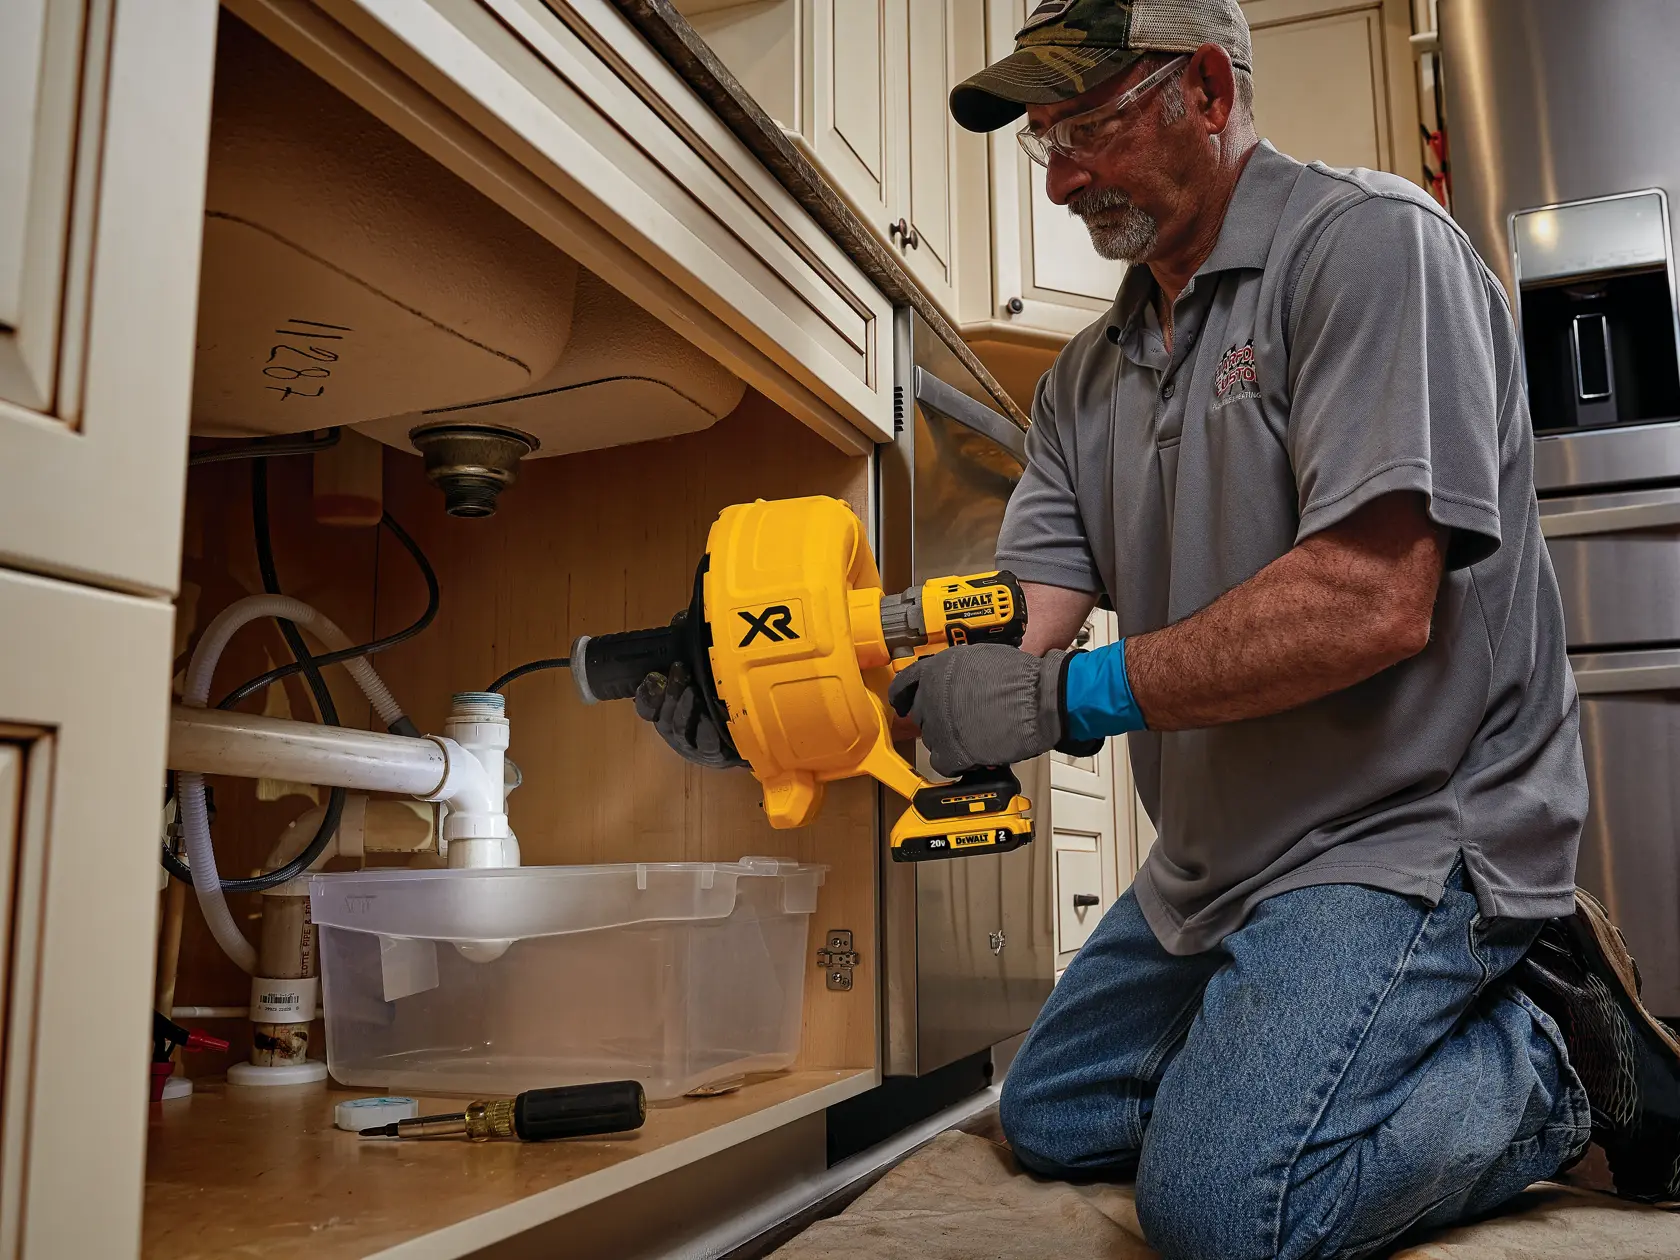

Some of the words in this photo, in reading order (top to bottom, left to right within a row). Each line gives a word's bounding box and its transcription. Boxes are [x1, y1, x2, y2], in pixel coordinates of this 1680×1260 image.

[263, 319, 354, 401] 11287
[737, 605, 800, 648] XR
[302, 928, 311, 947] PIPE
